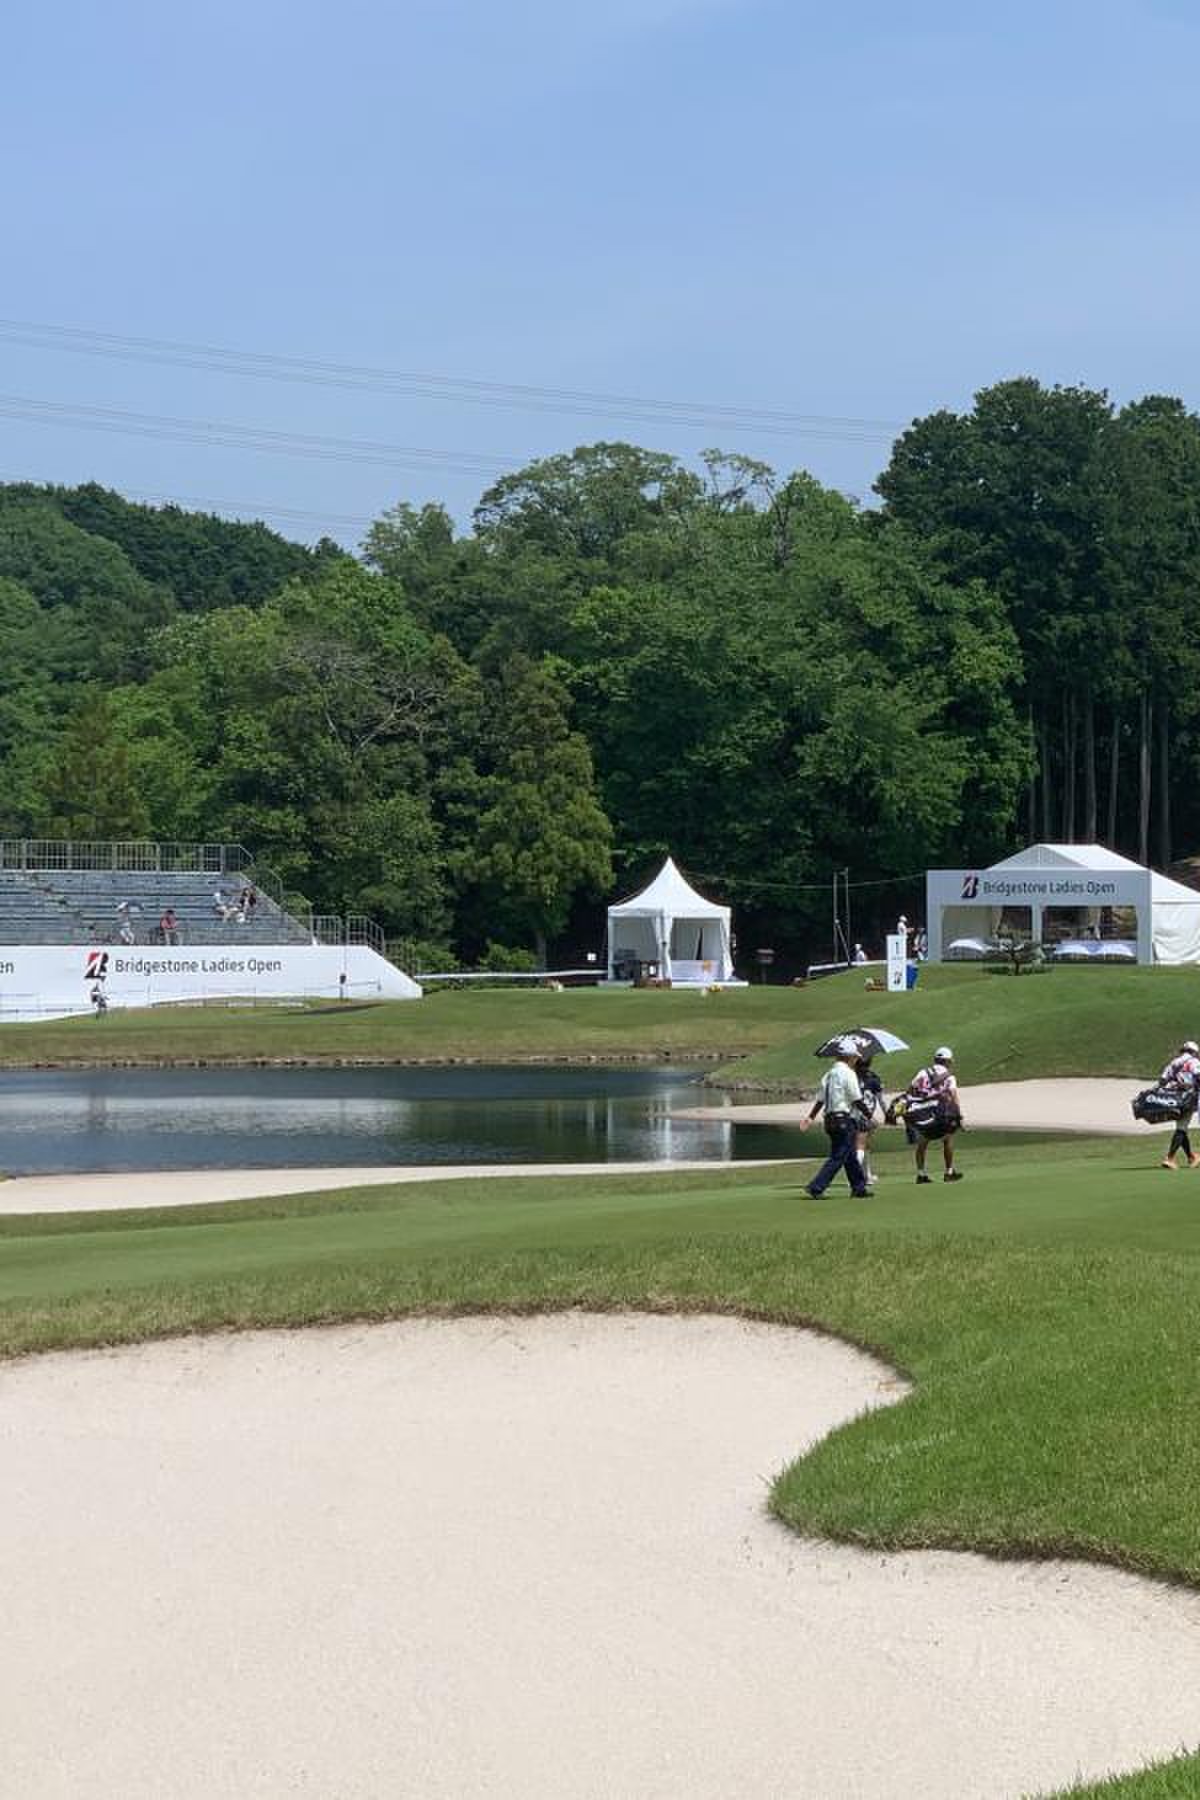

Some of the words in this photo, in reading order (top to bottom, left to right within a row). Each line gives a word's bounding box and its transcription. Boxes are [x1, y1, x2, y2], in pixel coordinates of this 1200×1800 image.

[983, 881, 1047, 896] Bridgestone
[1049, 881, 1084, 893] Ladies
[1087, 881, 1115, 895] Open
[114, 958, 200, 976] Bridgestone
[202, 958, 245, 972] Ladies
[248, 958, 282, 974] Open
